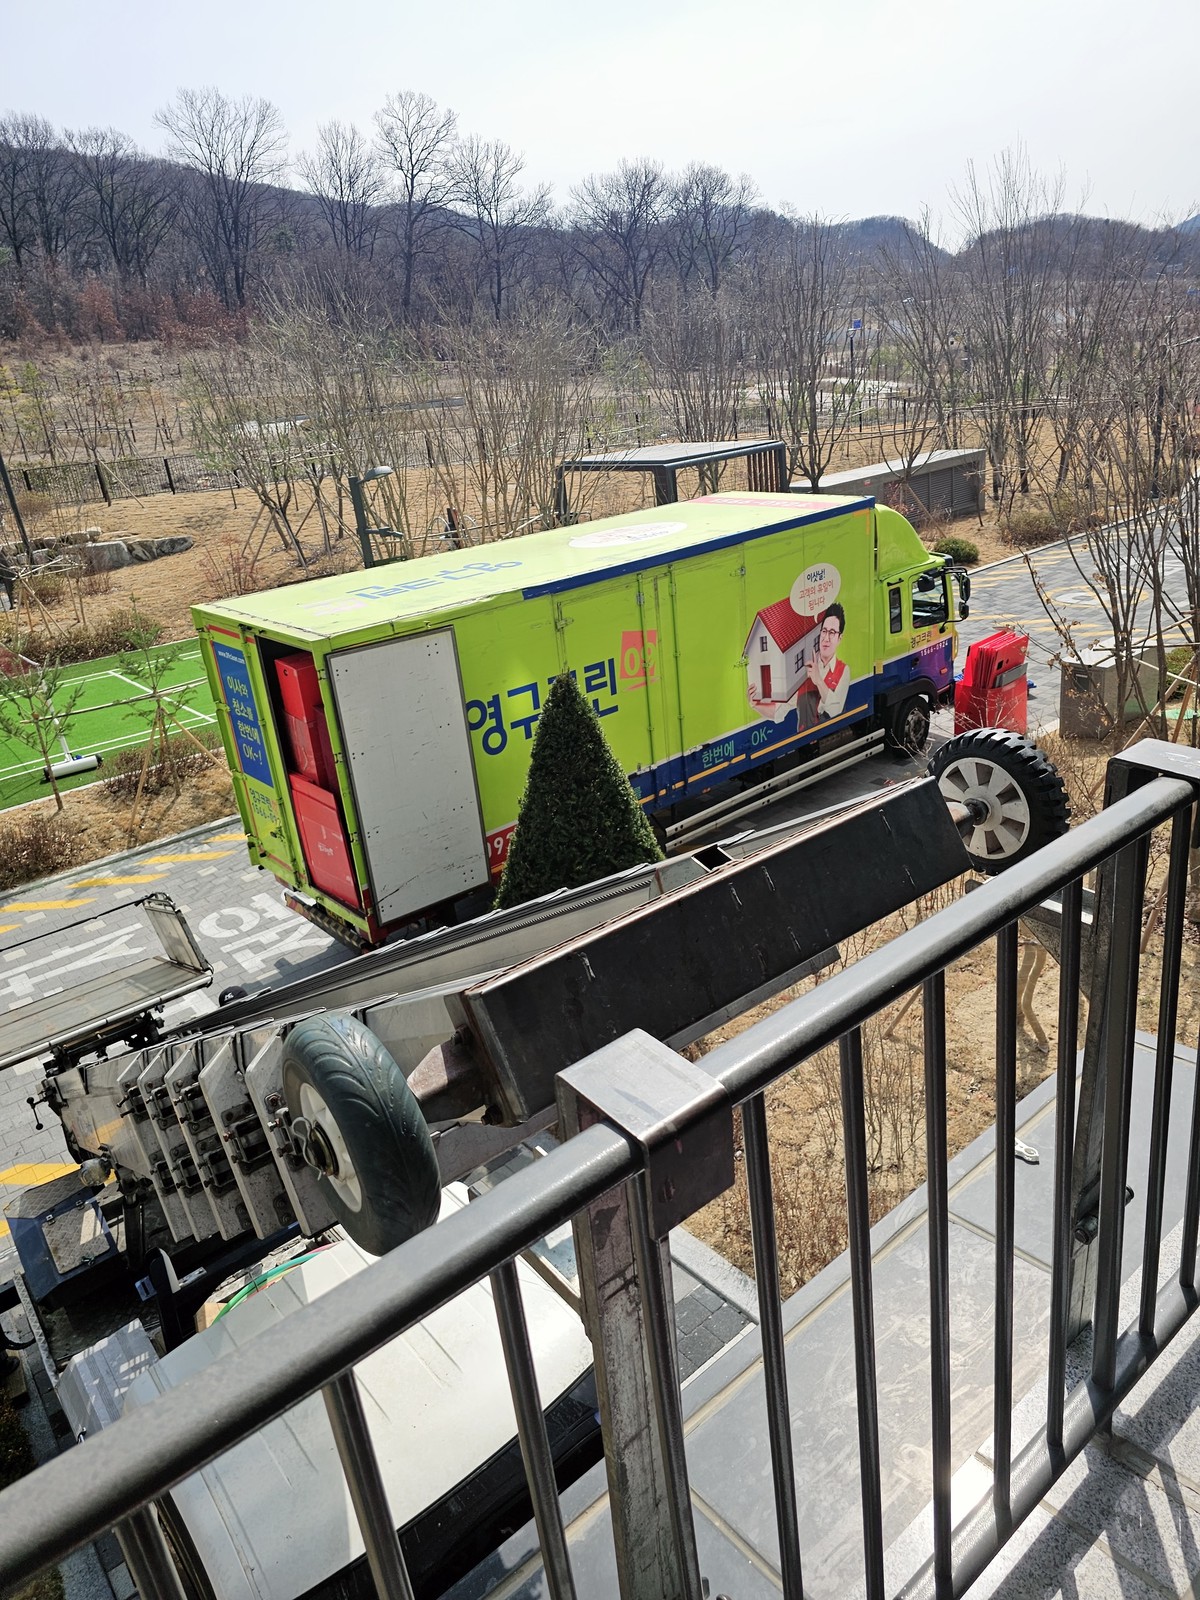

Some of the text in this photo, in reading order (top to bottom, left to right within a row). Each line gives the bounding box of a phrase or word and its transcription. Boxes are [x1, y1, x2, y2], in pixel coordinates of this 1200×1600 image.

[806, 568, 826, 583] 이삿날!
[808, 596, 825, 611] 됩니다
[920, 640, 949, 657] 1566-0924
[226, 675, 249, 698] 이사와
[232, 698, 254, 721] 청소를
[465, 657, 619, 756] 영구린
[237, 720, 261, 745] 한번에
[702, 740, 735, 769] 한번에
